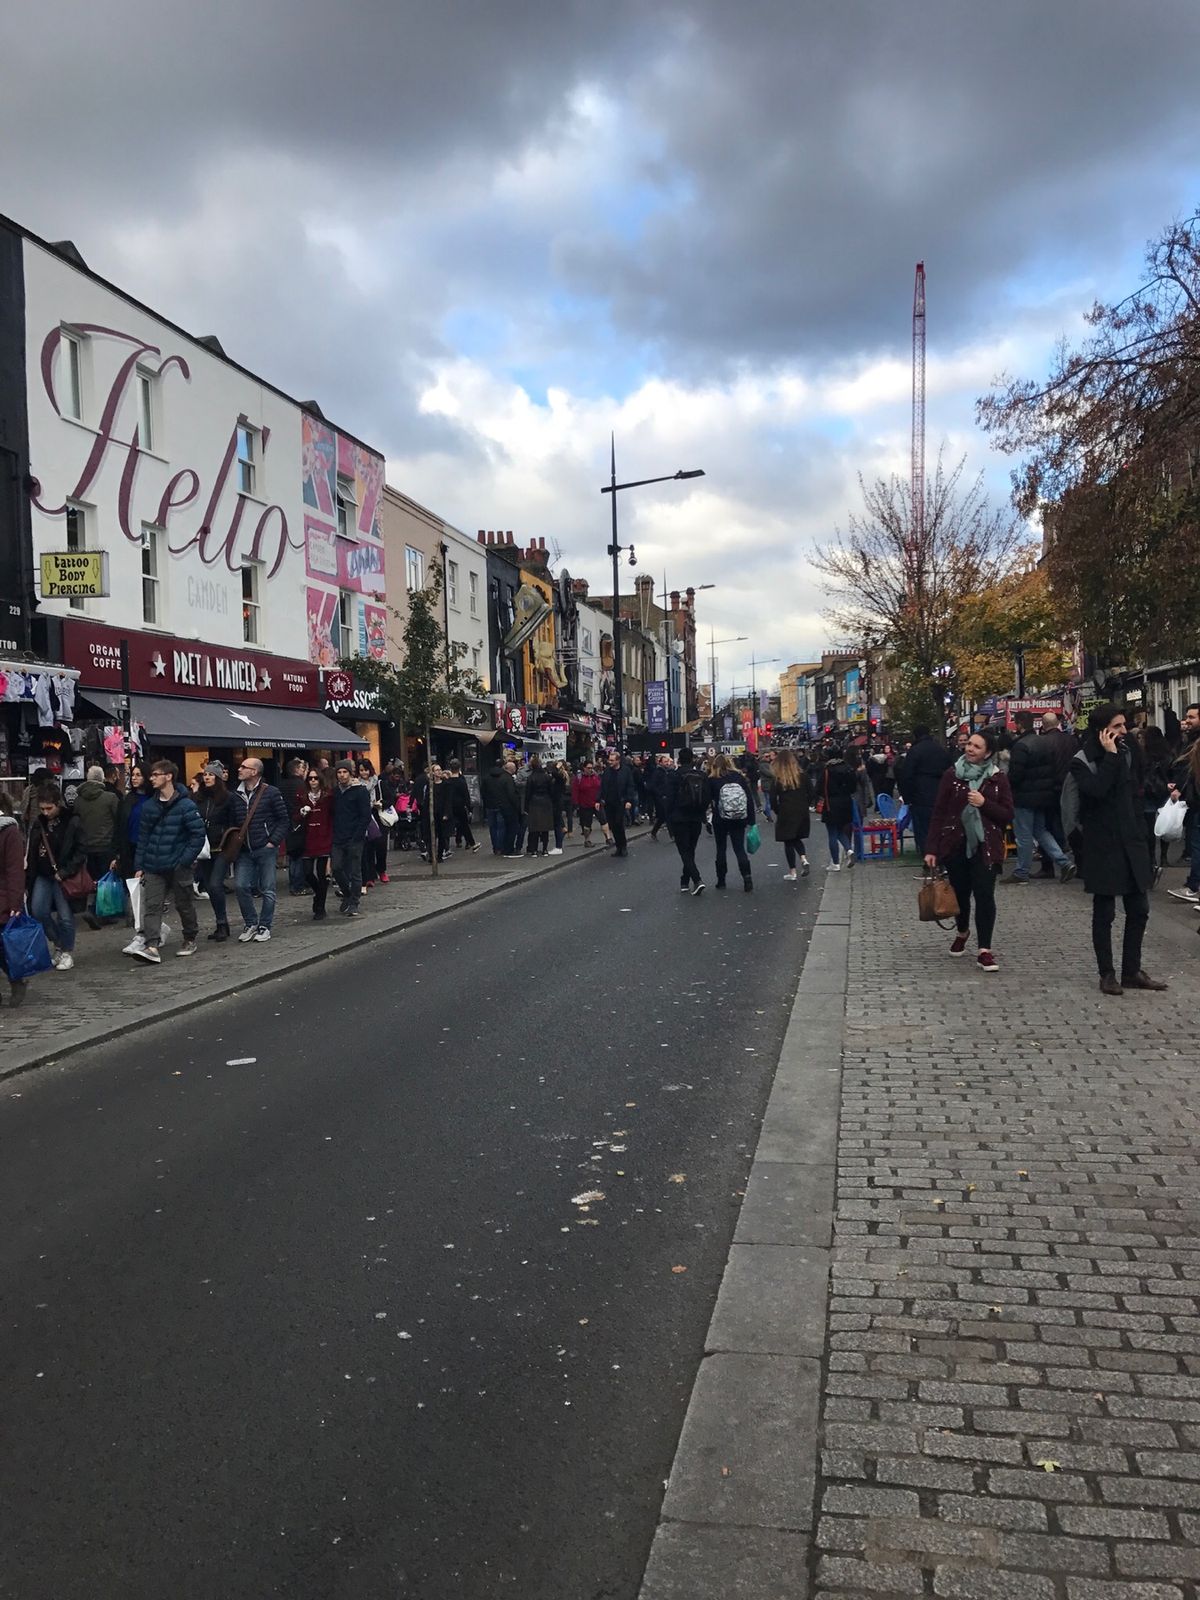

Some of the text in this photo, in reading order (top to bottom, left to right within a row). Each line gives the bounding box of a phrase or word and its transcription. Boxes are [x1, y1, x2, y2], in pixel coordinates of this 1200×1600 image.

[54, 556, 89, 568] tattoo
[187, 575, 229, 616] CAMDEN
[9, 605, 21, 616] 229
[89, 643, 121, 658] ORGAN
[93, 656, 122, 670] COFFE
[173, 650, 258, 692] PRET A MANGER
[283, 673, 308, 684] NATURAL
[289, 684, 303, 693] FOOD
